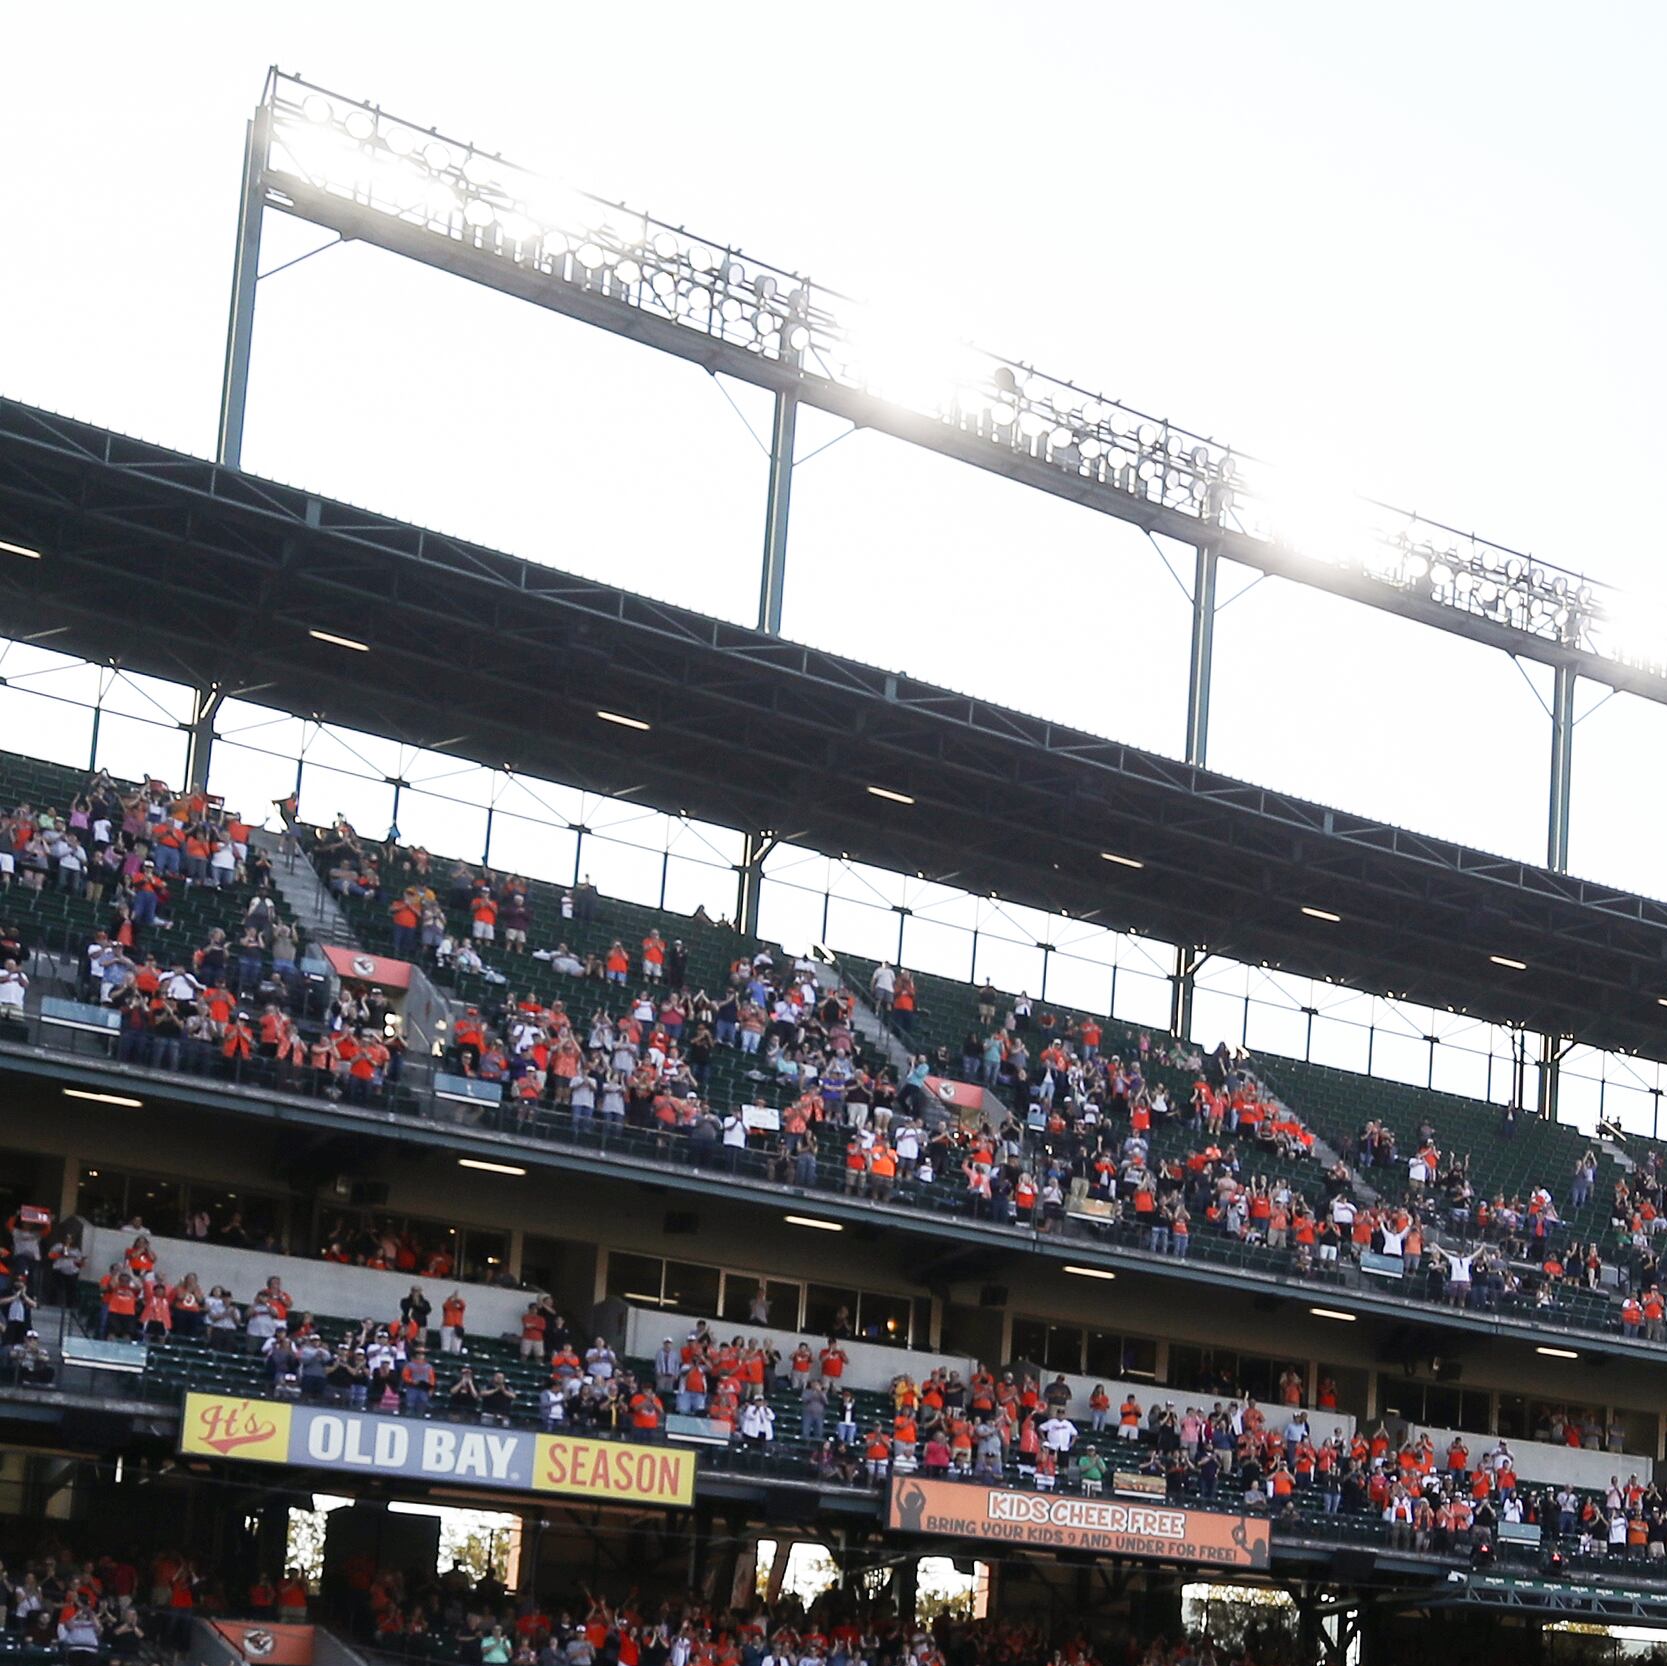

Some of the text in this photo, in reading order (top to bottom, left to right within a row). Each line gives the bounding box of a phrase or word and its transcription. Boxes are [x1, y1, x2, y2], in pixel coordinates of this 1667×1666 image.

[198, 1400, 273, 1446] It's
[308, 1415, 681, 1497] OLD BAY SEASON
[926, 1515, 1238, 1562] BRING YOUR KIDS 9 AND UNDER FOR FREE!
[989, 1491, 1186, 1539] KIDS CHEER FREE
